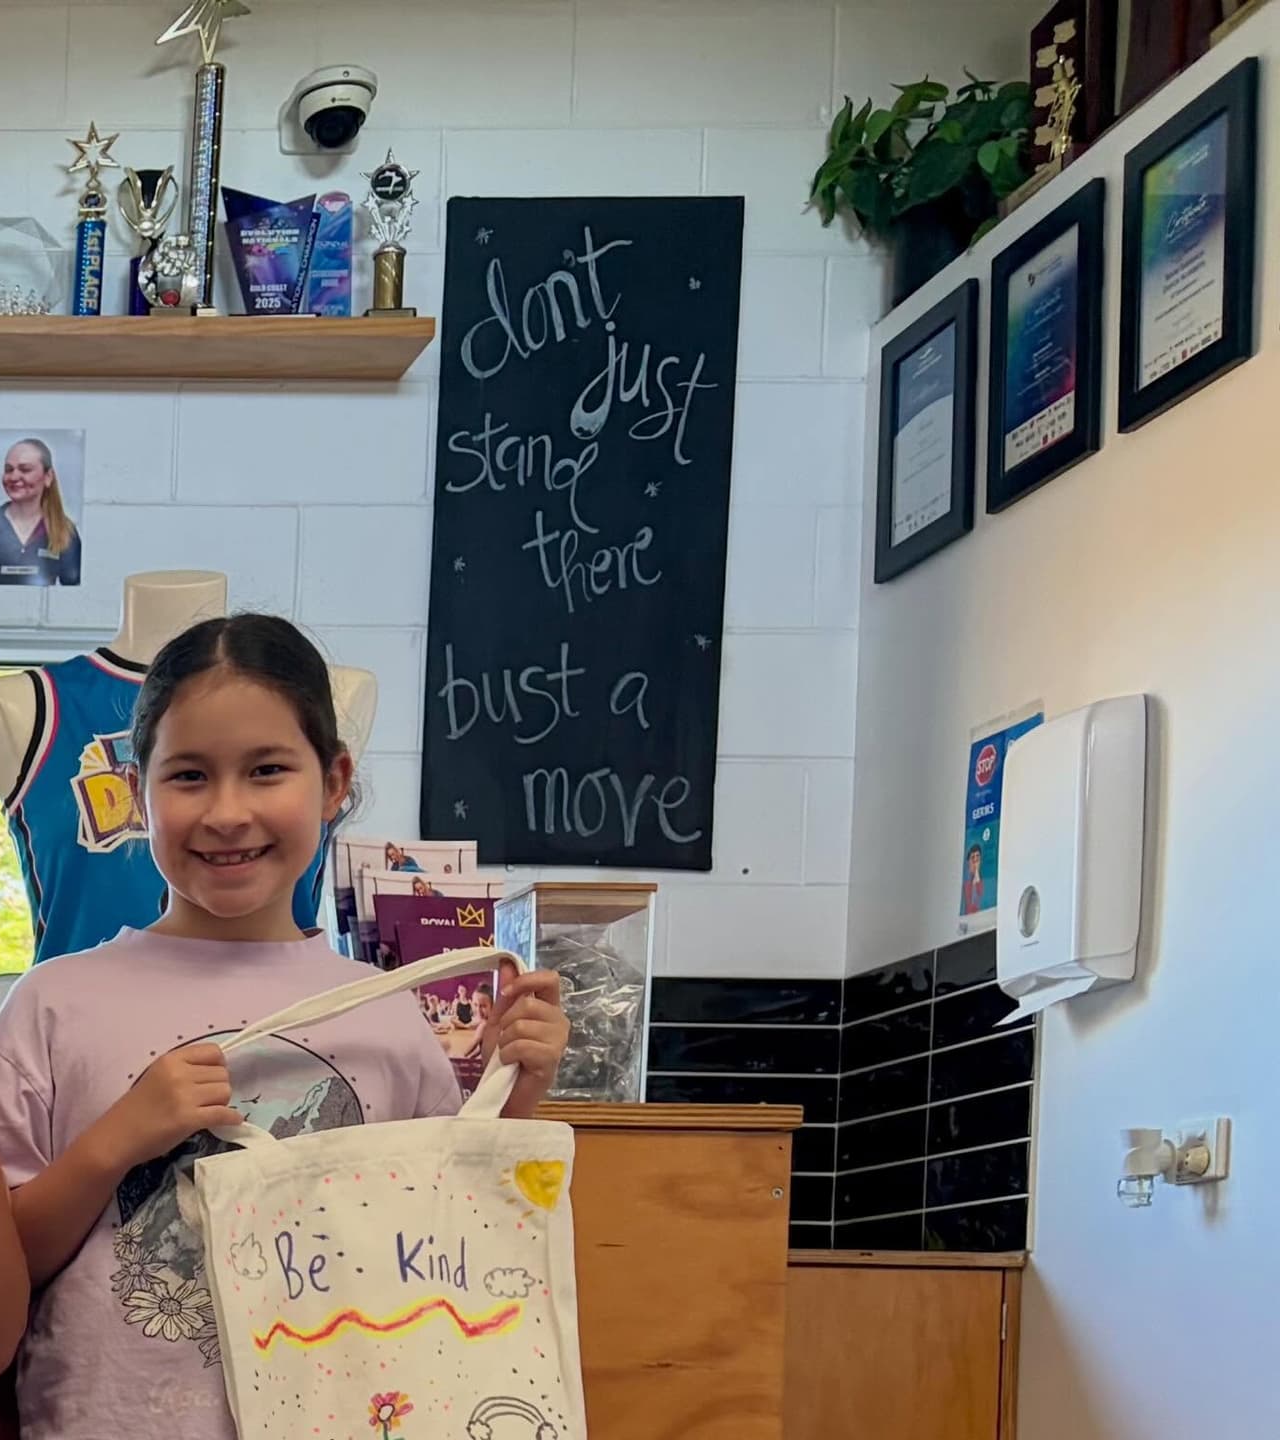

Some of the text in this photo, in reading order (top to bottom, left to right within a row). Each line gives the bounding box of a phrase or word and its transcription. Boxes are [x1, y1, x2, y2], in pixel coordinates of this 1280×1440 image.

[86, 255, 102, 309] PLACE
[254, 296, 282, 309] 2025
[570, 321, 719, 465] just
[445, 412, 600, 534] stand
[522, 511, 662, 614] there
[438, 642, 650, 744] bust a
[976, 755, 995, 776] STOP
[523, 767, 703, 847] move
[972, 802, 995, 820] GERMS
[274, 1231, 469, 1300] Be Kind
